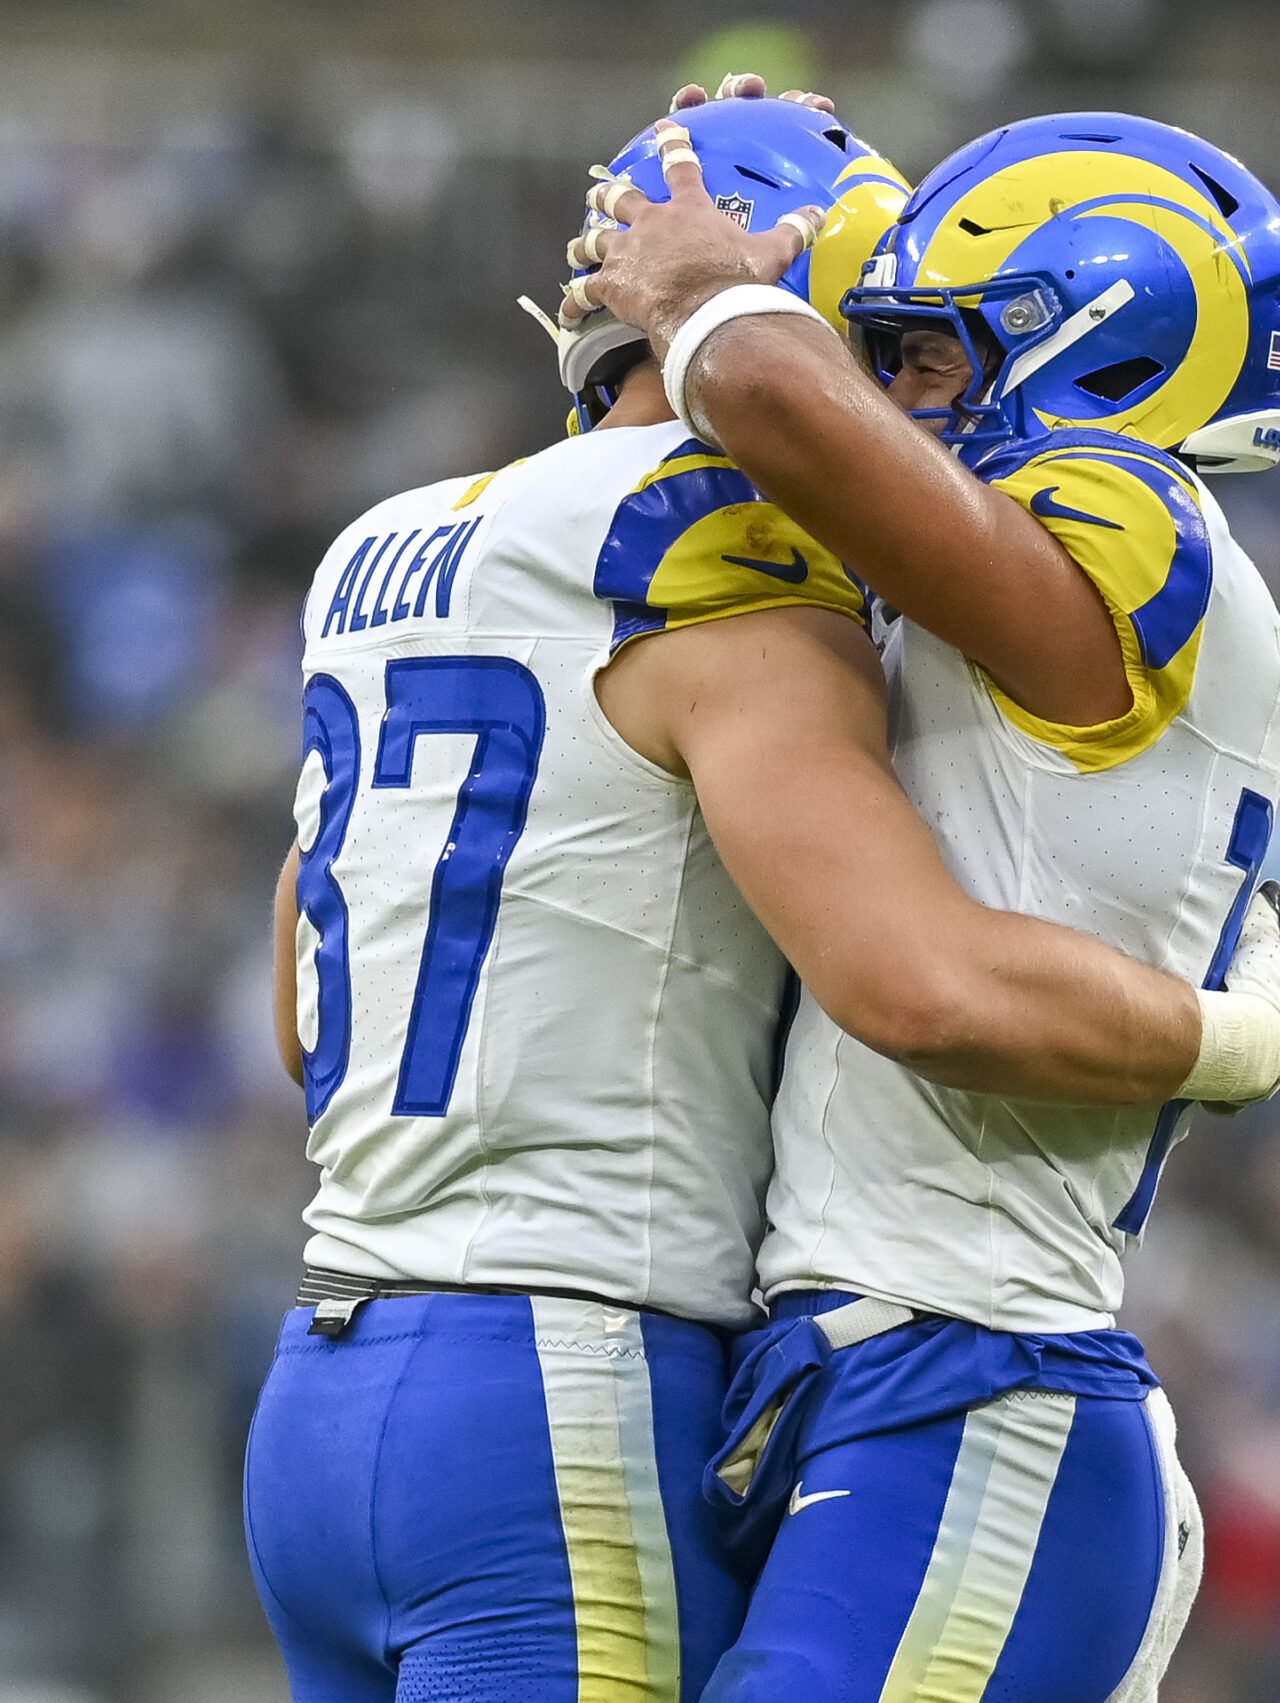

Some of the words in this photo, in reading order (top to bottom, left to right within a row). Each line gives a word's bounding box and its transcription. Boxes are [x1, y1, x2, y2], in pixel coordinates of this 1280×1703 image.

[720, 210, 745, 229] FL
[322, 516, 483, 637] ALLEN
[298, 656, 546, 1127] 87
